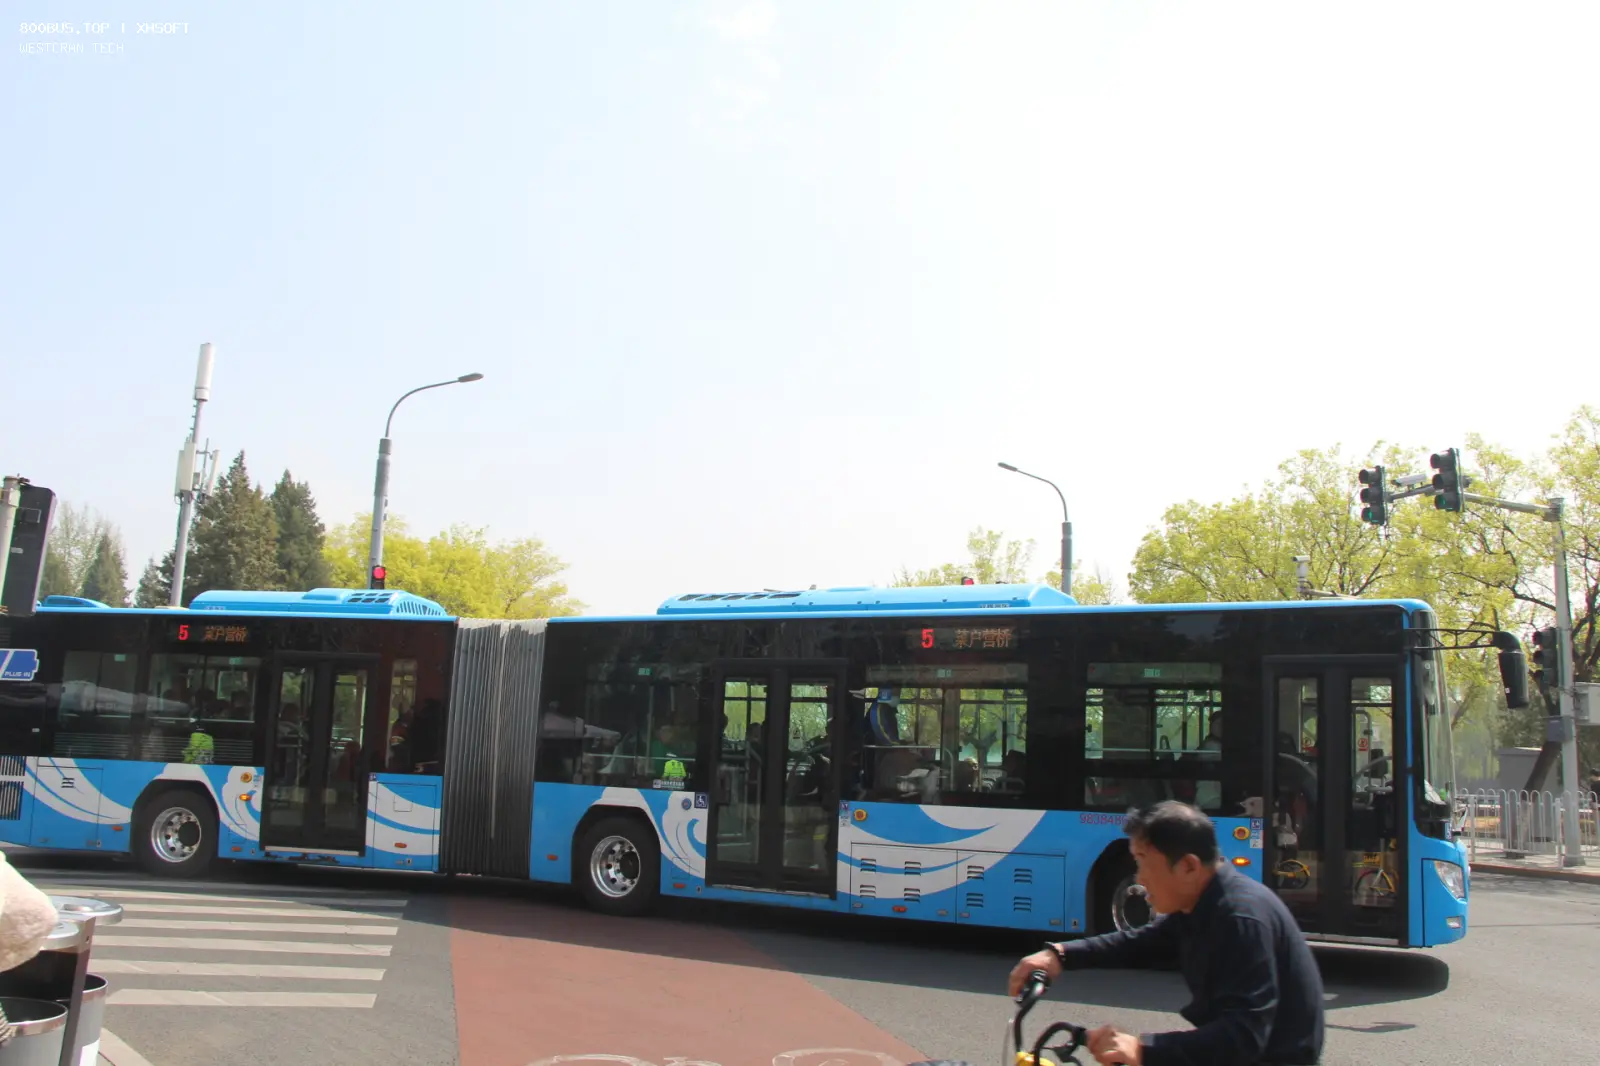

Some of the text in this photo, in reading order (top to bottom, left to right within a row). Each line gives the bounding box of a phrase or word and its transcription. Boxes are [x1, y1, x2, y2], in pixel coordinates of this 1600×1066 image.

[178, 625, 189, 641] 5
[921, 628, 934, 648] 5
[954, 627, 1013, 649] 菜户营桥
